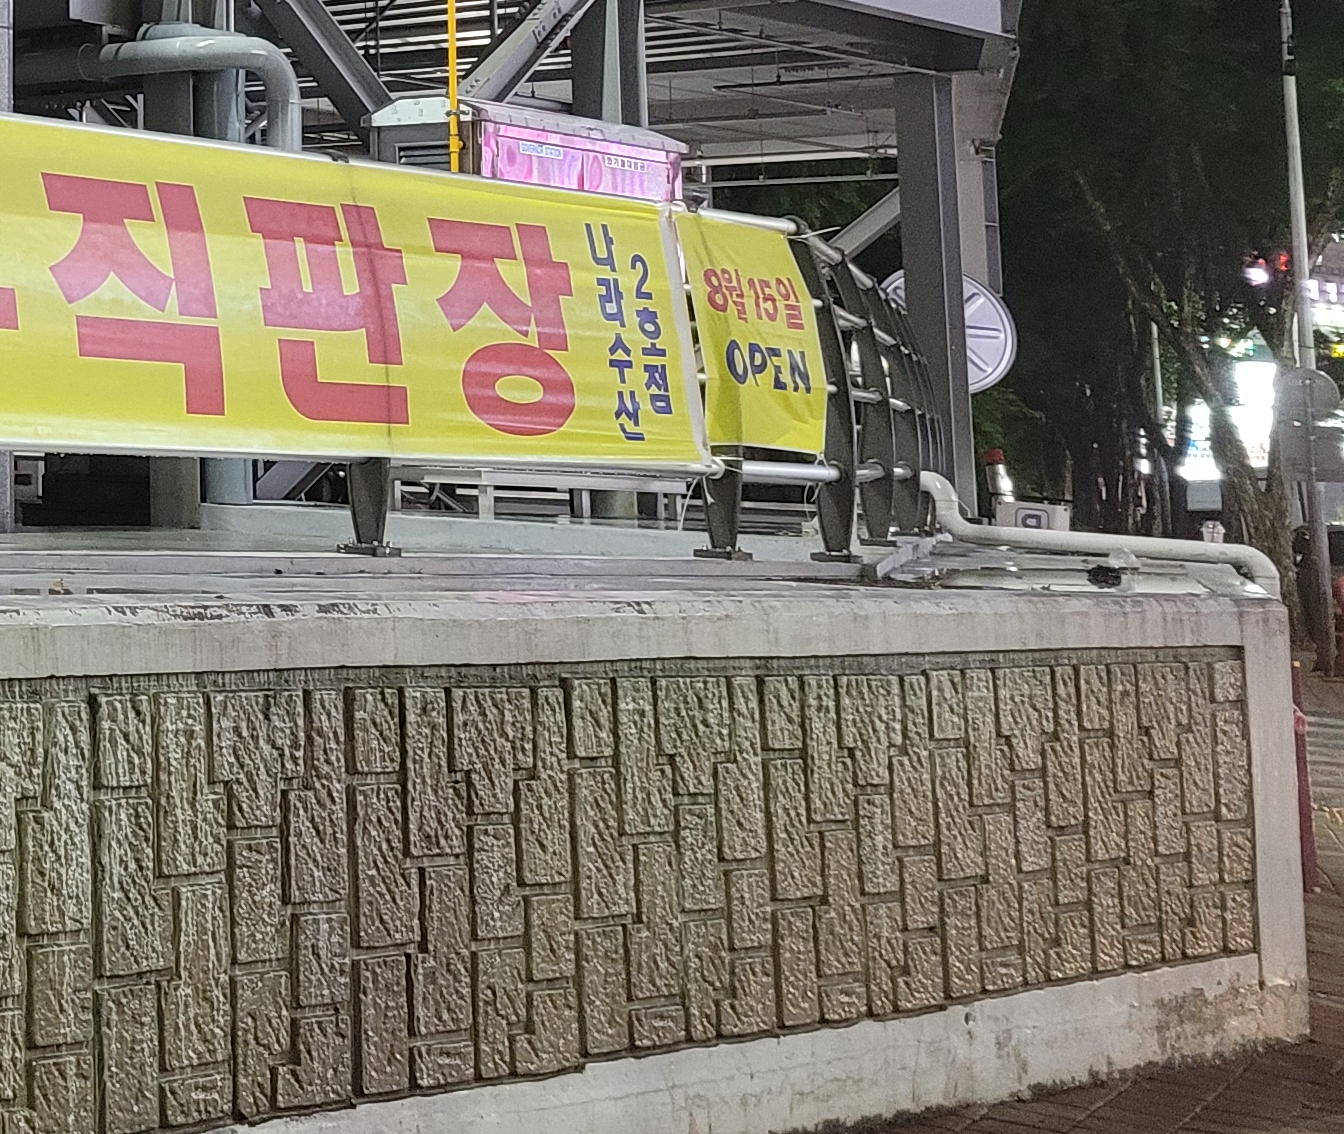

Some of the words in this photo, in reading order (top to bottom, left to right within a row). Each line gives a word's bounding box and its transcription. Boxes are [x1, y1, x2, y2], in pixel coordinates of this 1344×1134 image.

[584, 222, 646, 442] 나라수산
[630, 253, 673, 415] 2호점
[725, 338, 812, 395] OPEN
